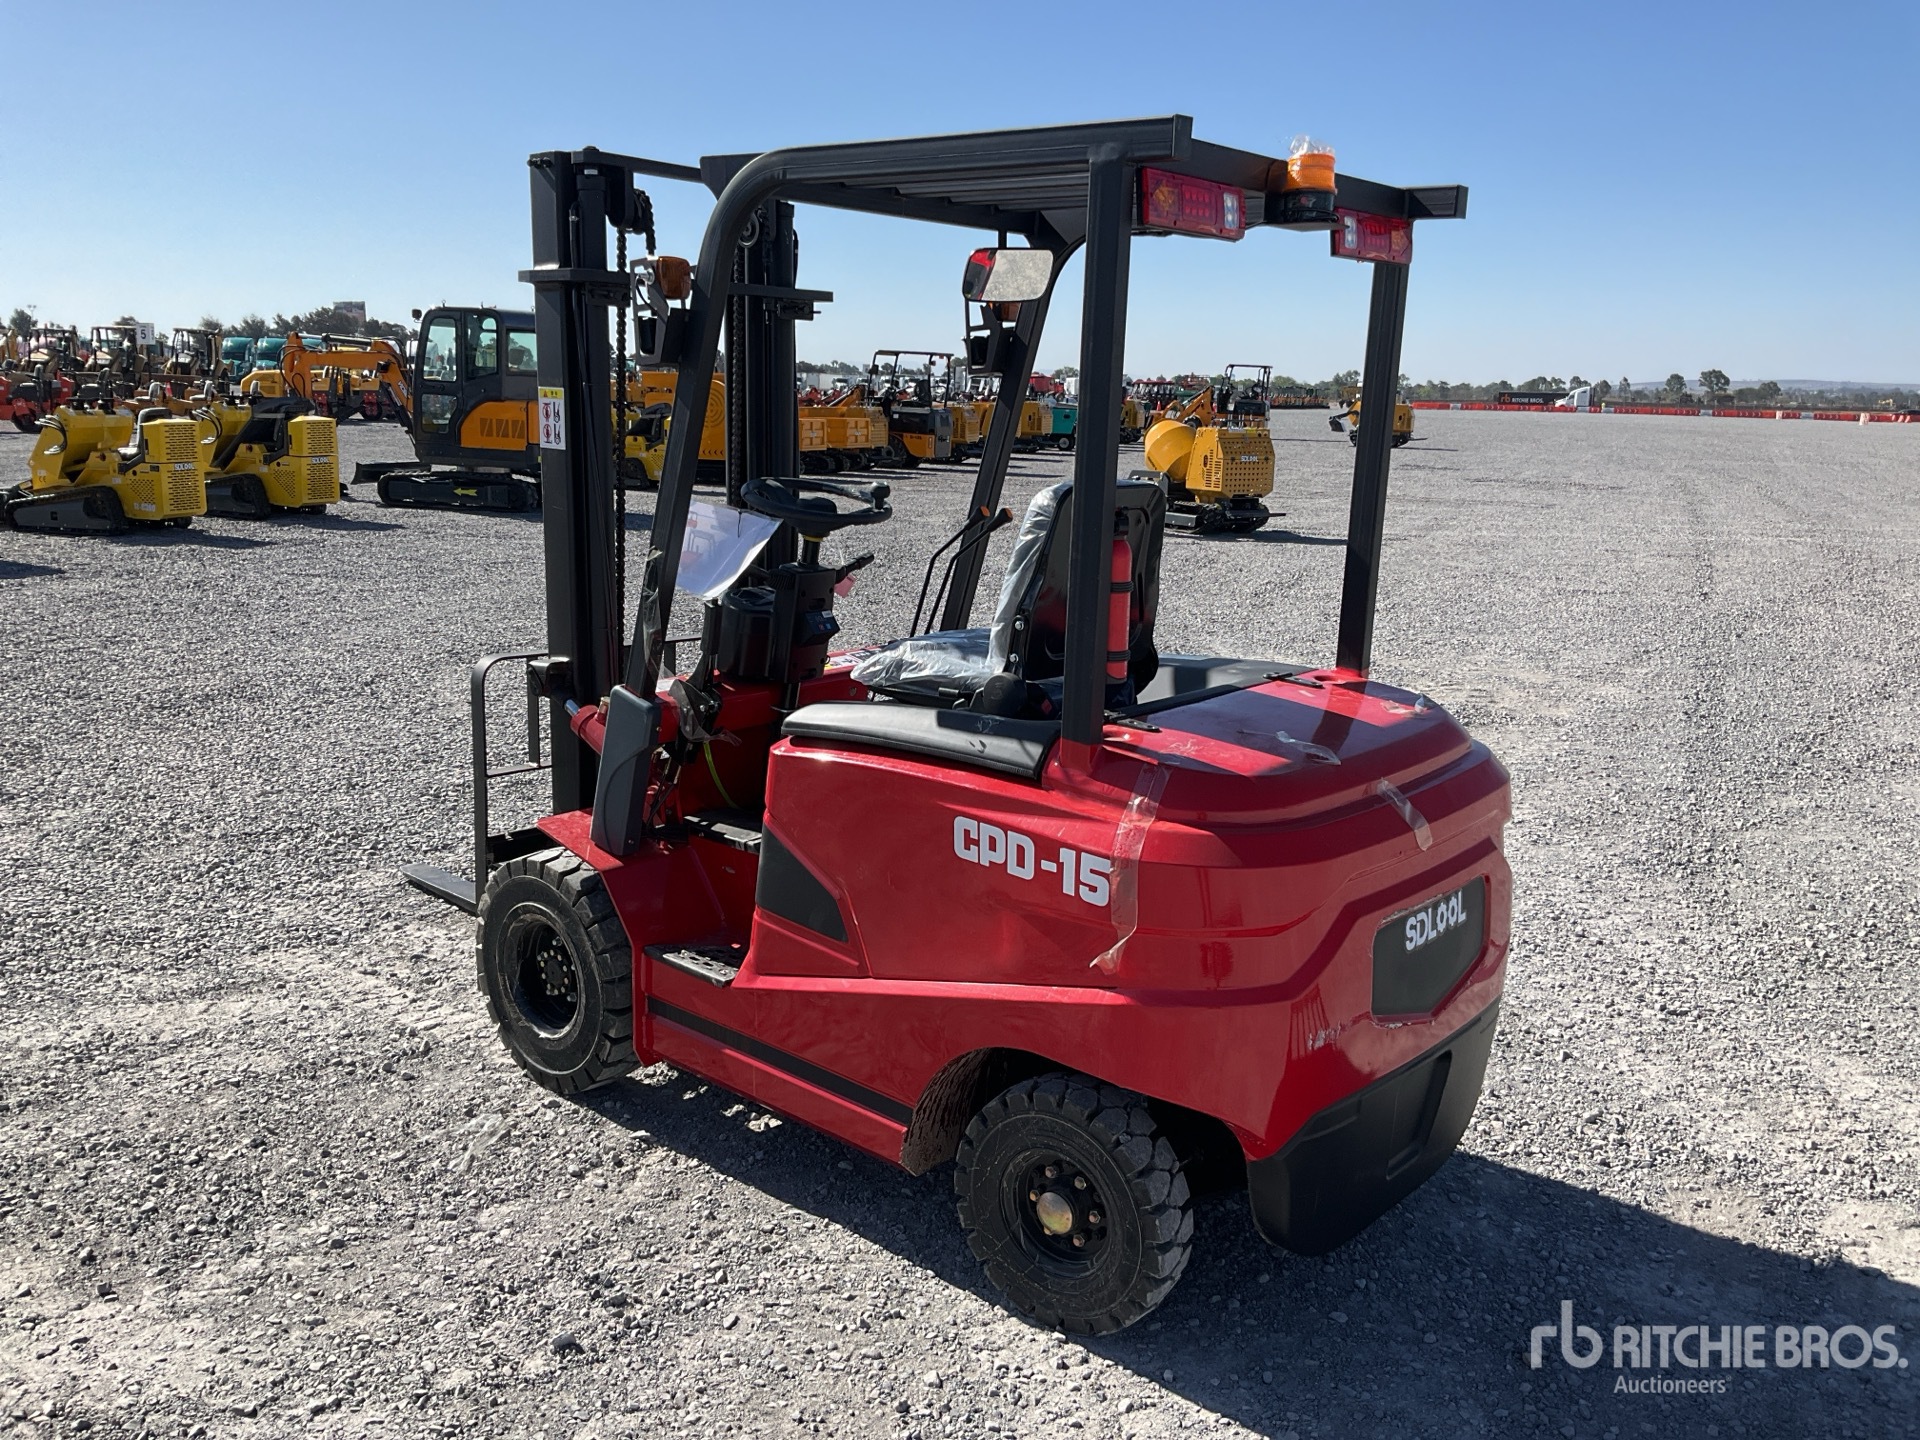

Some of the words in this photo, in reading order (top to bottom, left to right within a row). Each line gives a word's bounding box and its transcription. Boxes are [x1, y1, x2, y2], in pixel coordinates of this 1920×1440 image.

[140, 329, 147, 339] 5
[953, 815, 1111, 907] CPD-15
[1405, 890, 1467, 951] SDLOOL
